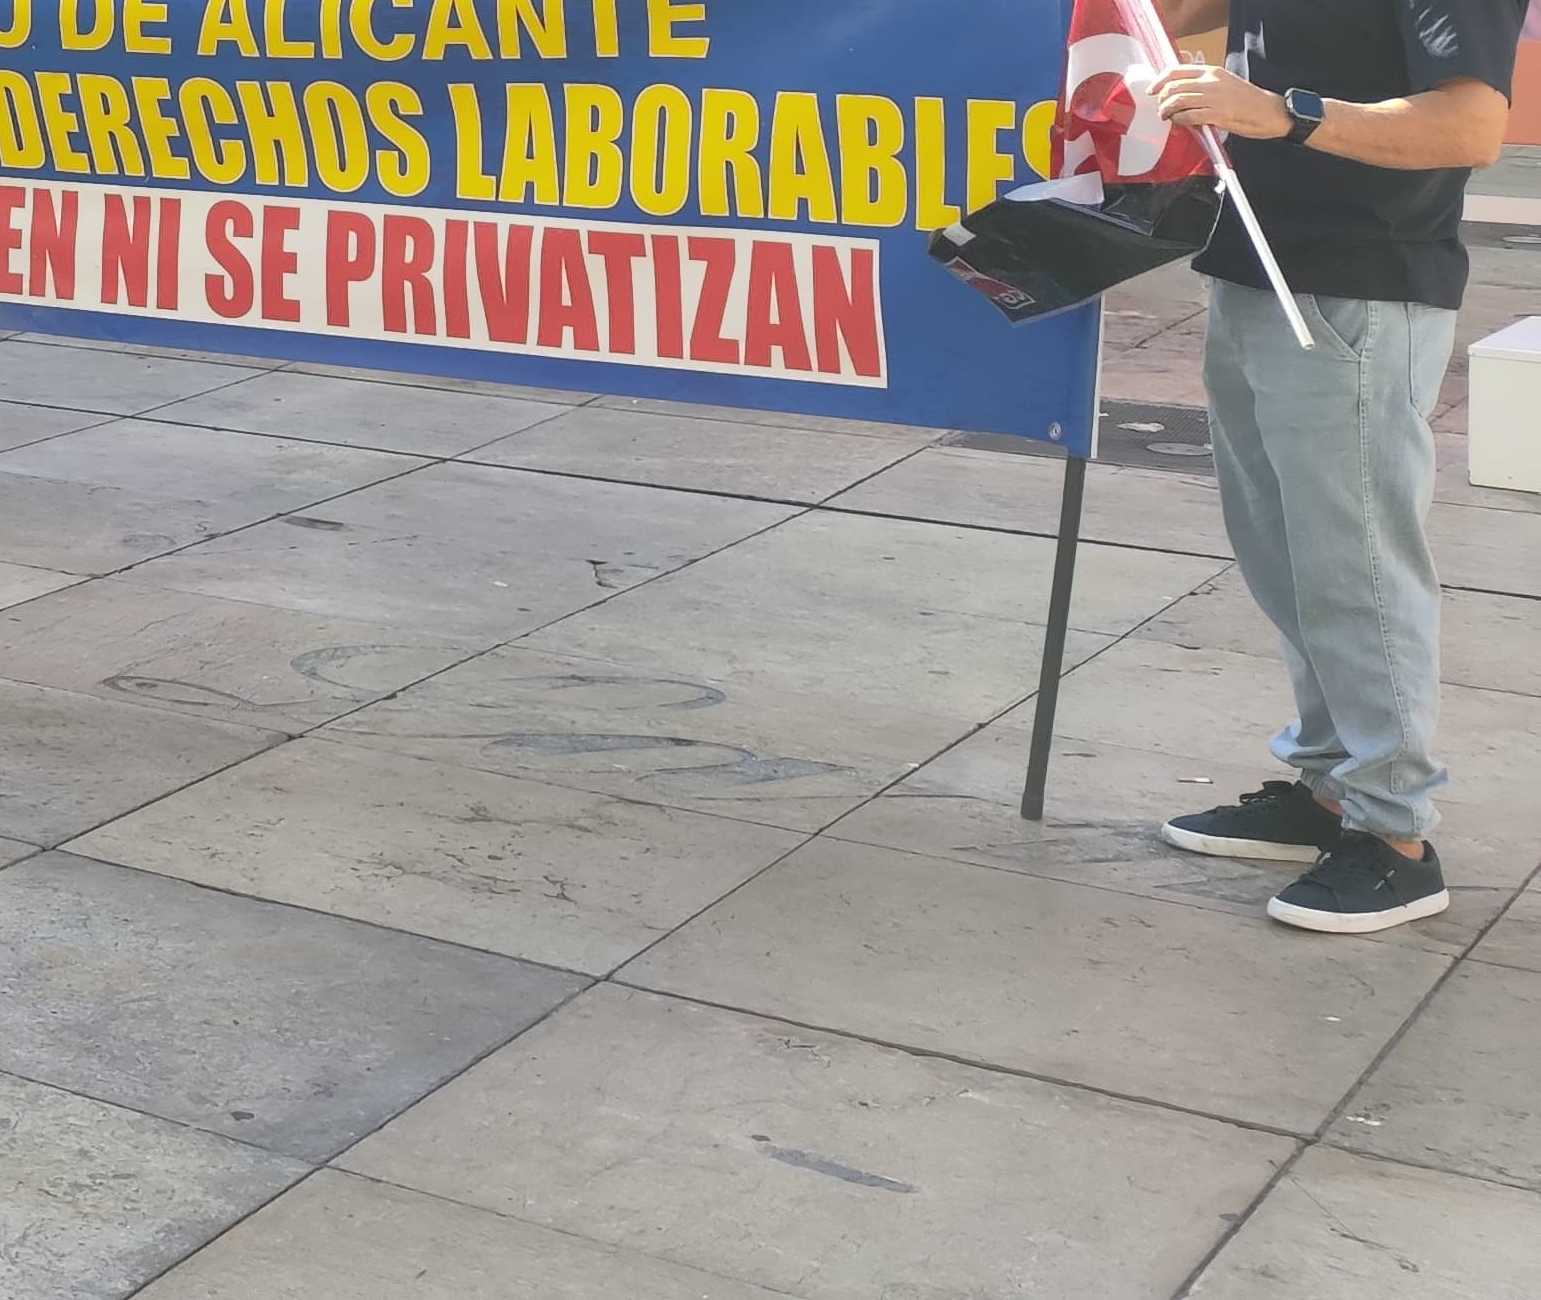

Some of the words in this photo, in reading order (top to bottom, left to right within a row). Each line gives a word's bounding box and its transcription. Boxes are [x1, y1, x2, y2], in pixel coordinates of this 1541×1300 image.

[100, 191, 182, 311] NI
[204, 199, 302, 323] SE
[325, 209, 883, 379] PRIVATIZAN
